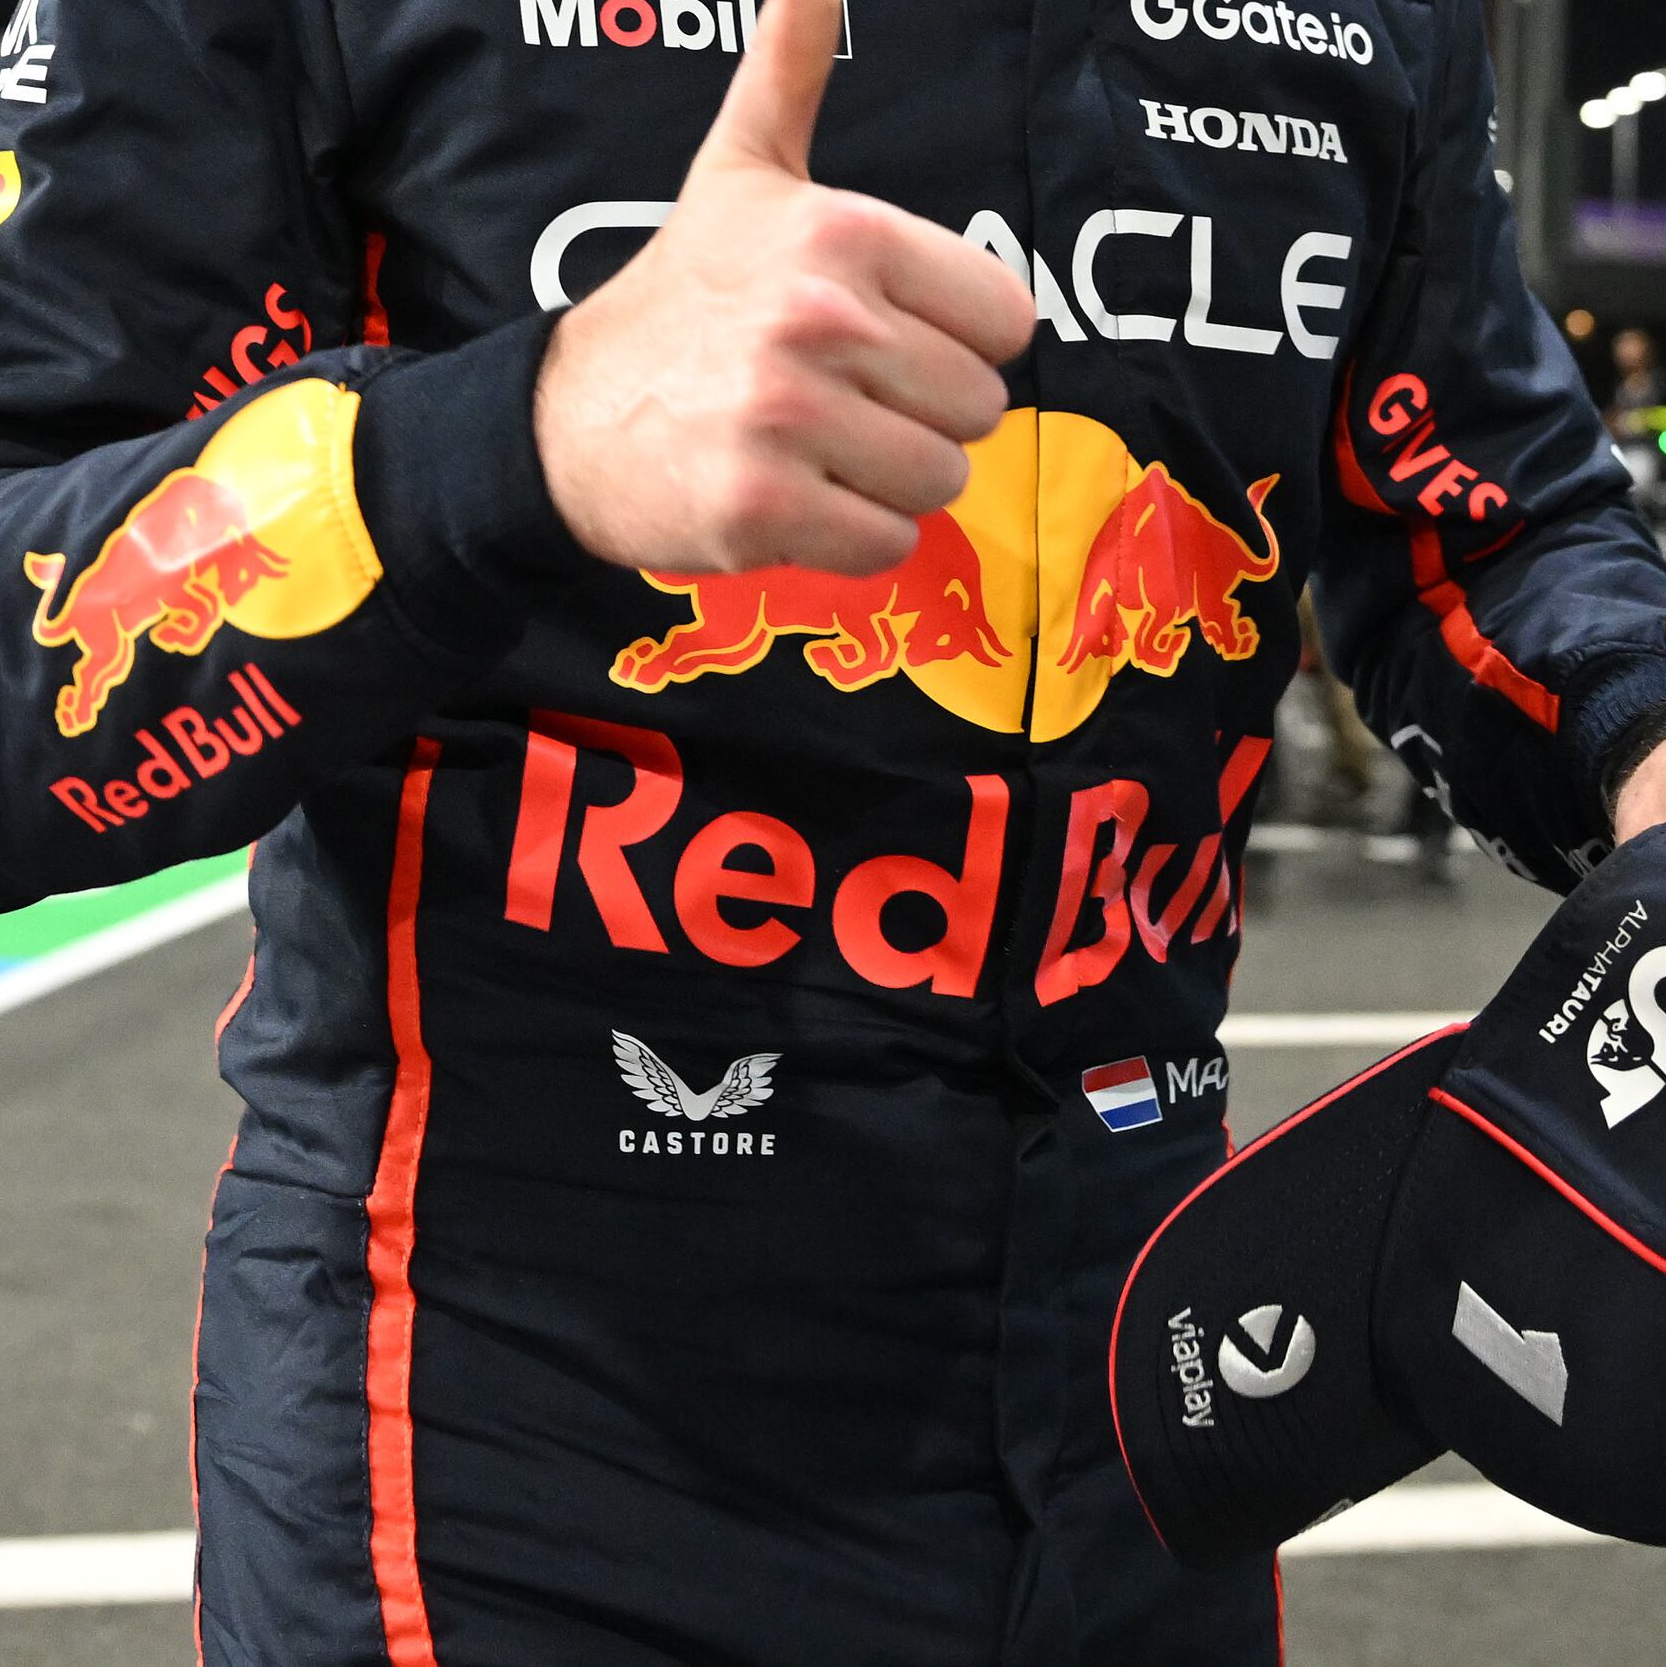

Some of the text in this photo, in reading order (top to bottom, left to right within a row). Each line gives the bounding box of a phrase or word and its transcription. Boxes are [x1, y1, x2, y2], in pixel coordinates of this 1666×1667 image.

[1139, 98, 1349, 164] HONDA
[530, 200, 1353, 360] ACLE
[49, 662, 303, 835] Red Bull
[505, 709, 1011, 1000] Red
[1538, 899, 1649, 1044] ALPHATAURI
[619, 1129, 776, 1156] CASTORE
[1166, 1306, 1216, 1430] viaplay
